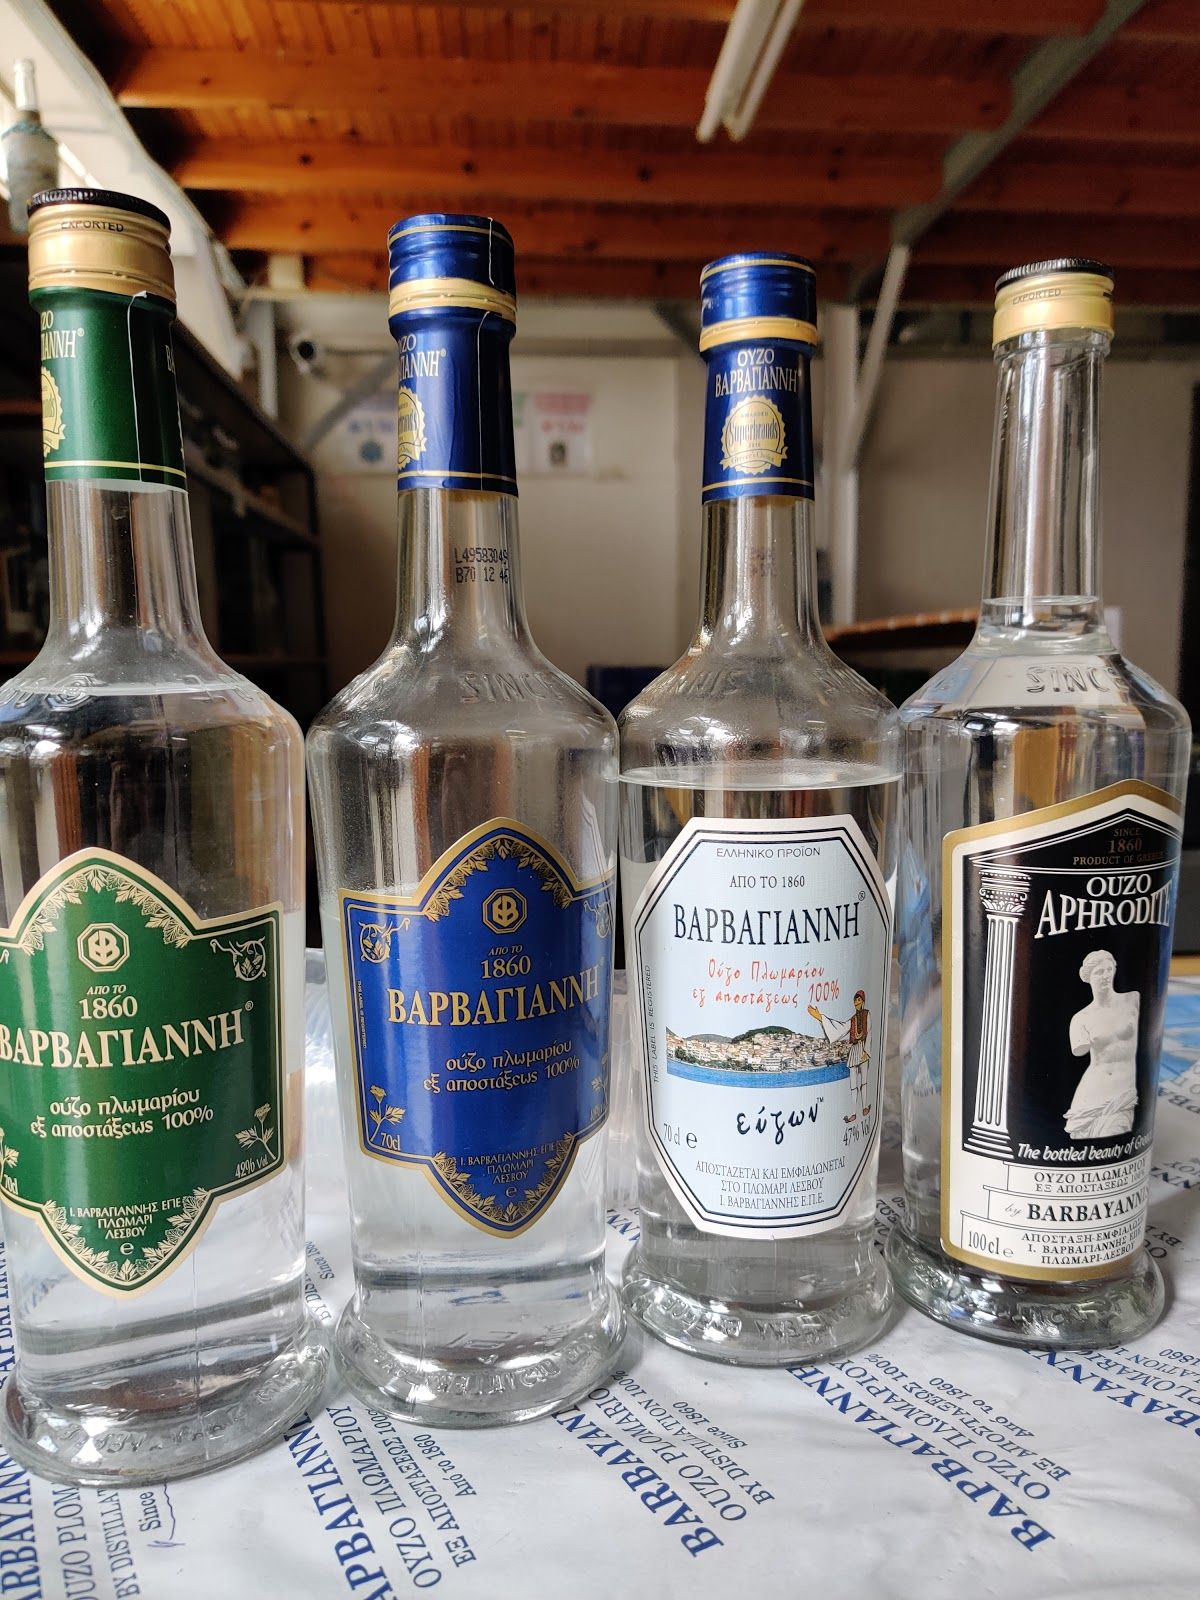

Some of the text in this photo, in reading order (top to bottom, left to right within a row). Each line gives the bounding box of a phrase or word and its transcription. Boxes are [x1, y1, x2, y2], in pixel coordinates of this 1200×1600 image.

[1012, 288, 1062, 305] EXPORTED
[736, 348, 775, 367] ΟΥΖΟ
[1113, 827, 1141, 837] SINCE
[716, 847, 774, 859] ΕΛΛΗΝΙΚΟ
[1107, 837, 1143, 854] 1860
[1072, 855, 1120, 866] PRODUCT
[1123, 854, 1135, 864] OF
[729, 875, 806, 888] ΑΠΟ ΤΟ 1860
[1086, 873, 1152, 897] OUZO
[488, 944, 523, 956] ΑΠΟ ΤΟ
[480, 955, 531, 979] 1860
[86, 983, 127, 996] ΑΠΟ ΤΟ
[644, 965, 655, 1018] REGISTERED
[808, 979, 840, 1003] 100%
[79, 996, 138, 1020] 1860
[446, 1038, 572, 1073] ούζο πλωμαρίου
[446, 1070, 538, 1094] αποστάξεως
[544, 1055, 581, 1080] 100%
[50, 1088, 200, 1119] ούζο πλωμαρίου
[52, 1117, 153, 1139] αποστάξεως
[162, 1105, 214, 1131] 100%
[1017, 1142, 1039, 1160] The
[1043, 1145, 1085, 1162] bottled
[1088, 1143, 1123, 1160] beauty
[1124, 1137, 1135, 1155] of
[235, 1158, 255, 1178] 42%
[486, 1159, 535, 1175] ΠΛΩΜΑΡΙ
[492, 1171, 529, 1185] ΛΕΣΒΟΥ
[695, 1160, 760, 1179] ΑΠΟΣΤΑΖΕΤΑΙ
[762, 1168, 779, 1180] ΚΑΙ
[1034, 1171, 1076, 1184] ΟΥΖΟ
[720, 1177, 824, 1195] ΣΤΟ ΠΛΩΜΑΡΙ ΛΕΣΒΟΥ
[1035, 1184, 1053, 1194] ΕΞ
[77, 1202, 159, 1219] ΒΑΡΒΑΓΙΑΝΝΗΣ
[161, 1197, 182, 1212] ΕΠΕ
[727, 1195, 799, 1210] ΒΑΡΒΑΓΙΑΝΝΗΣ
[1005, 1201, 1021, 1216] by
[97, 1213, 153, 1229] ΠΛΩΜΑΡΙ
[104, 1226, 148, 1240] ΛΕΣΒΟΥ
[867, 1353, 908, 1382] 100%
[929, 1377, 970, 1400] 1860
[672, 1401, 748, 1450] Since 1860
[829, 1359, 1050, 1500] ΟΥΖΟ ΠΛΩΜΑΡΙΟΥ
[413, 1433, 446, 1460] 1860
[612, 1370, 775, 1505] BY DISTILLATION 100%
[588, 1387, 747, 1521] OUZO PLOMARIO
[1032, 1458, 1071, 1482] ΕΞ
[326, 1406, 442, 1589] ΟΥΖΟ ΠΛΩΜΑΡΙΟΥ
[52, 1481, 88, 1546] PLOM
[139, 1490, 162, 1533] Since
[445, 1535, 477, 1568] ΕΞ
[114, 1571, 141, 1600] BY
